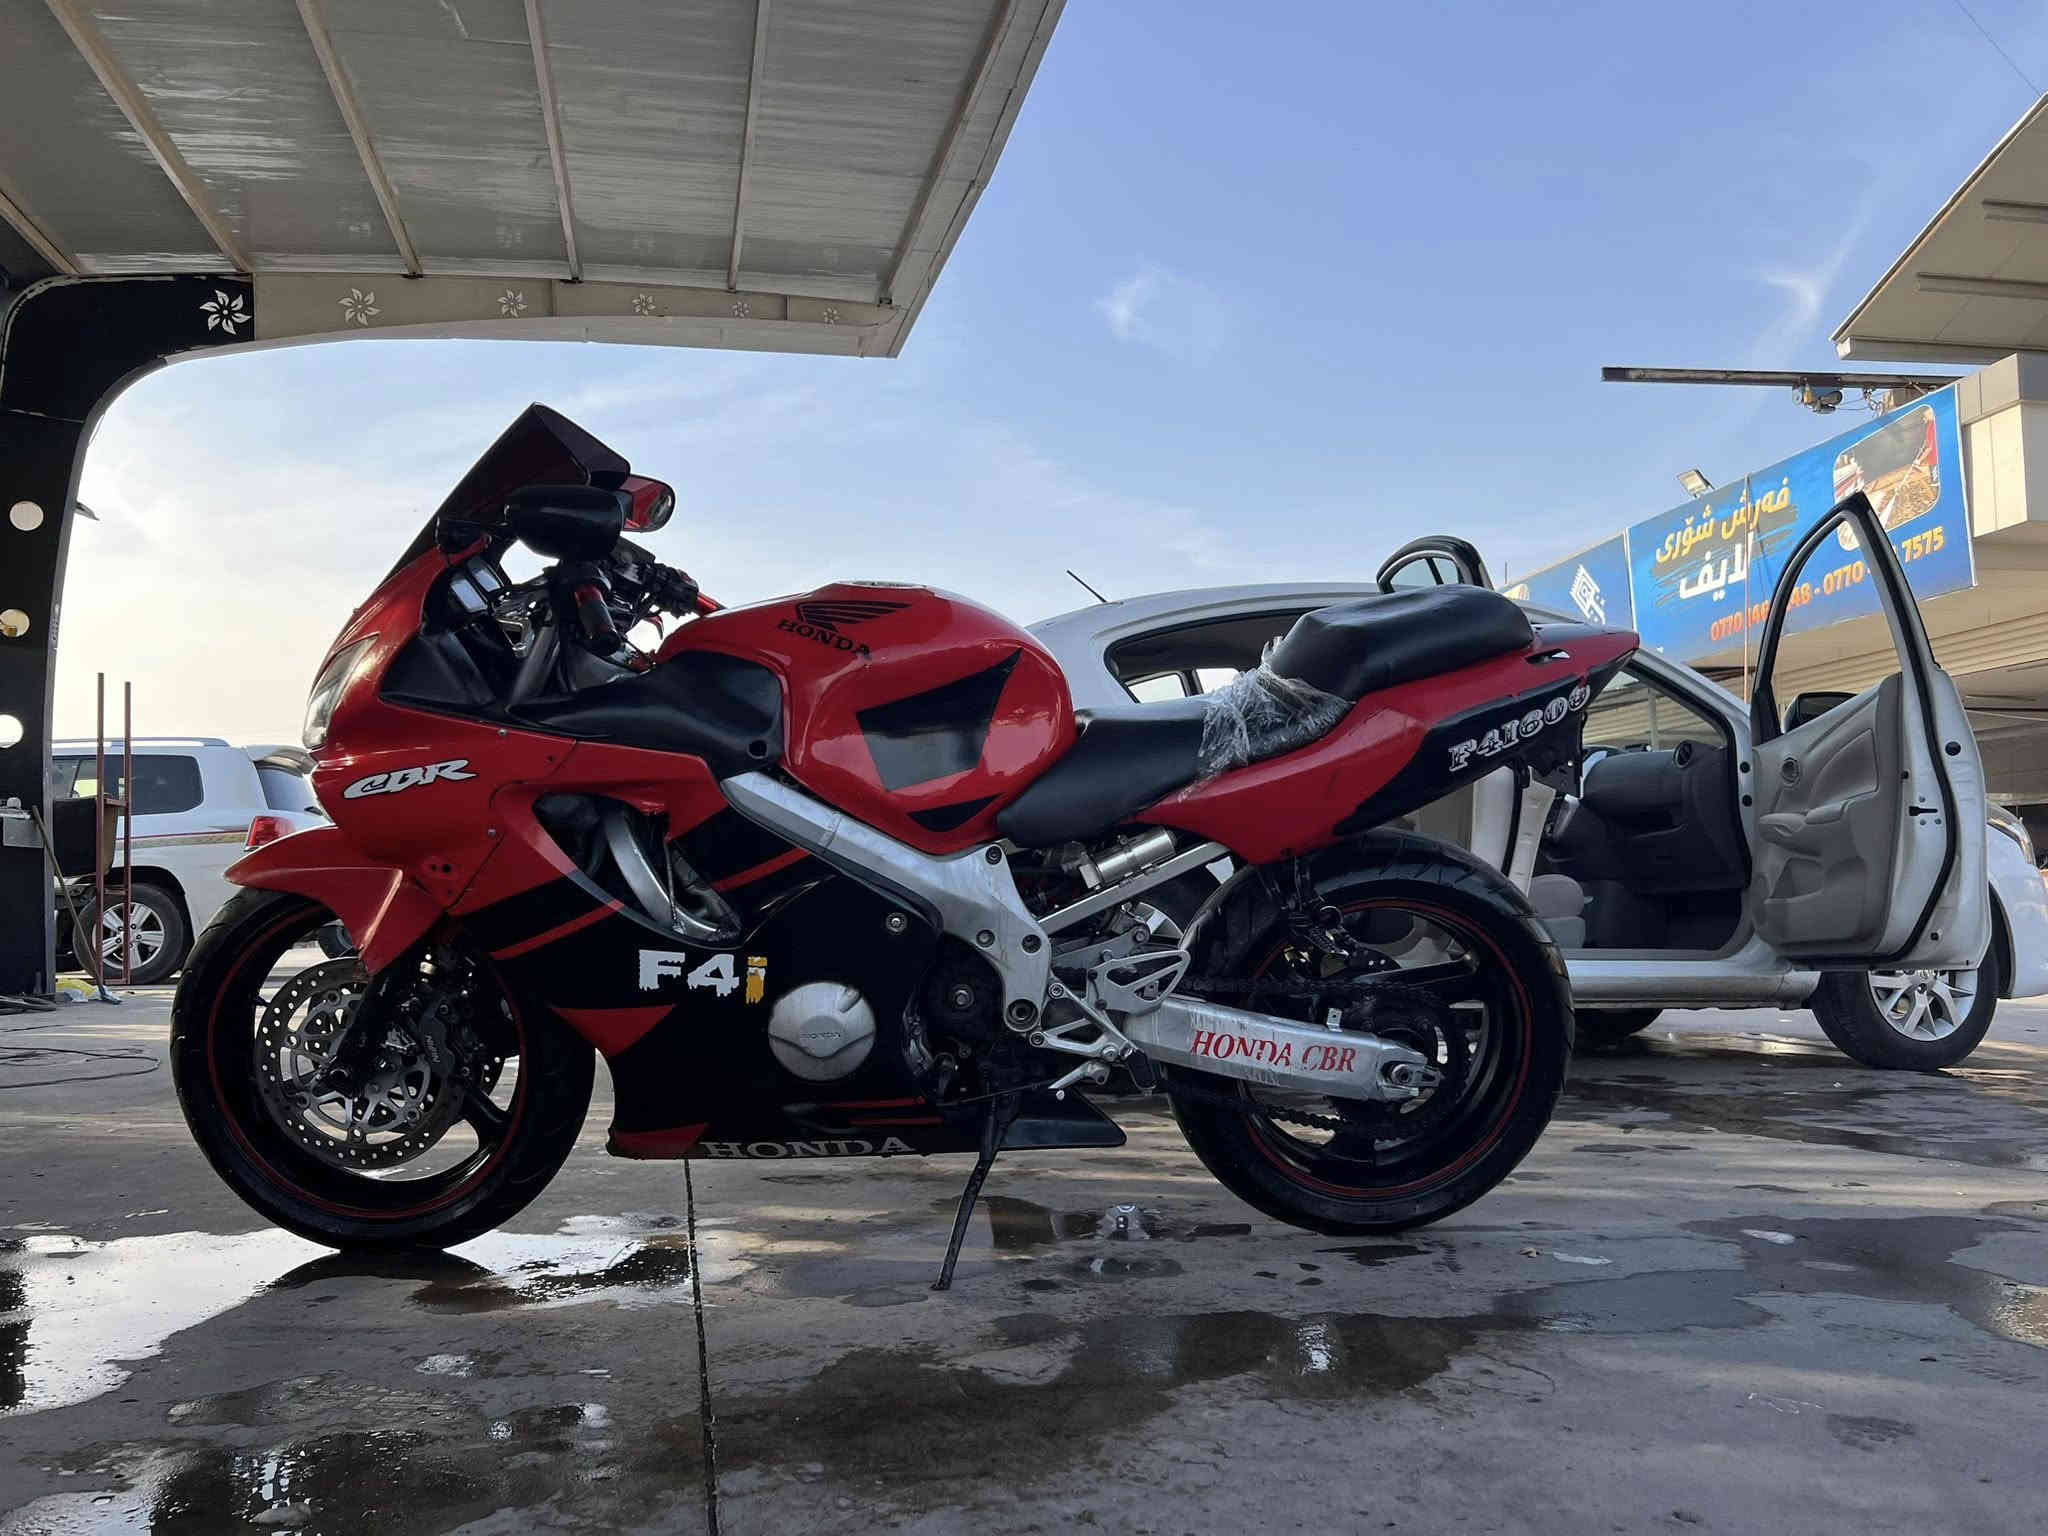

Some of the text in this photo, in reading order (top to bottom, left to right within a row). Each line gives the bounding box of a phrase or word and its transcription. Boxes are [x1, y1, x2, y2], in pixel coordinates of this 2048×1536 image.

[1823, 561, 1865, 595] 0770
[1902, 525, 1945, 562] 7575
[777, 619, 872, 660] HONDA
[343, 760, 477, 798] CBR
[639, 950, 767, 1004] F4i
[1190, 1030, 1359, 1072] HONDA CBR
[700, 1136, 916, 1158] HONDA
